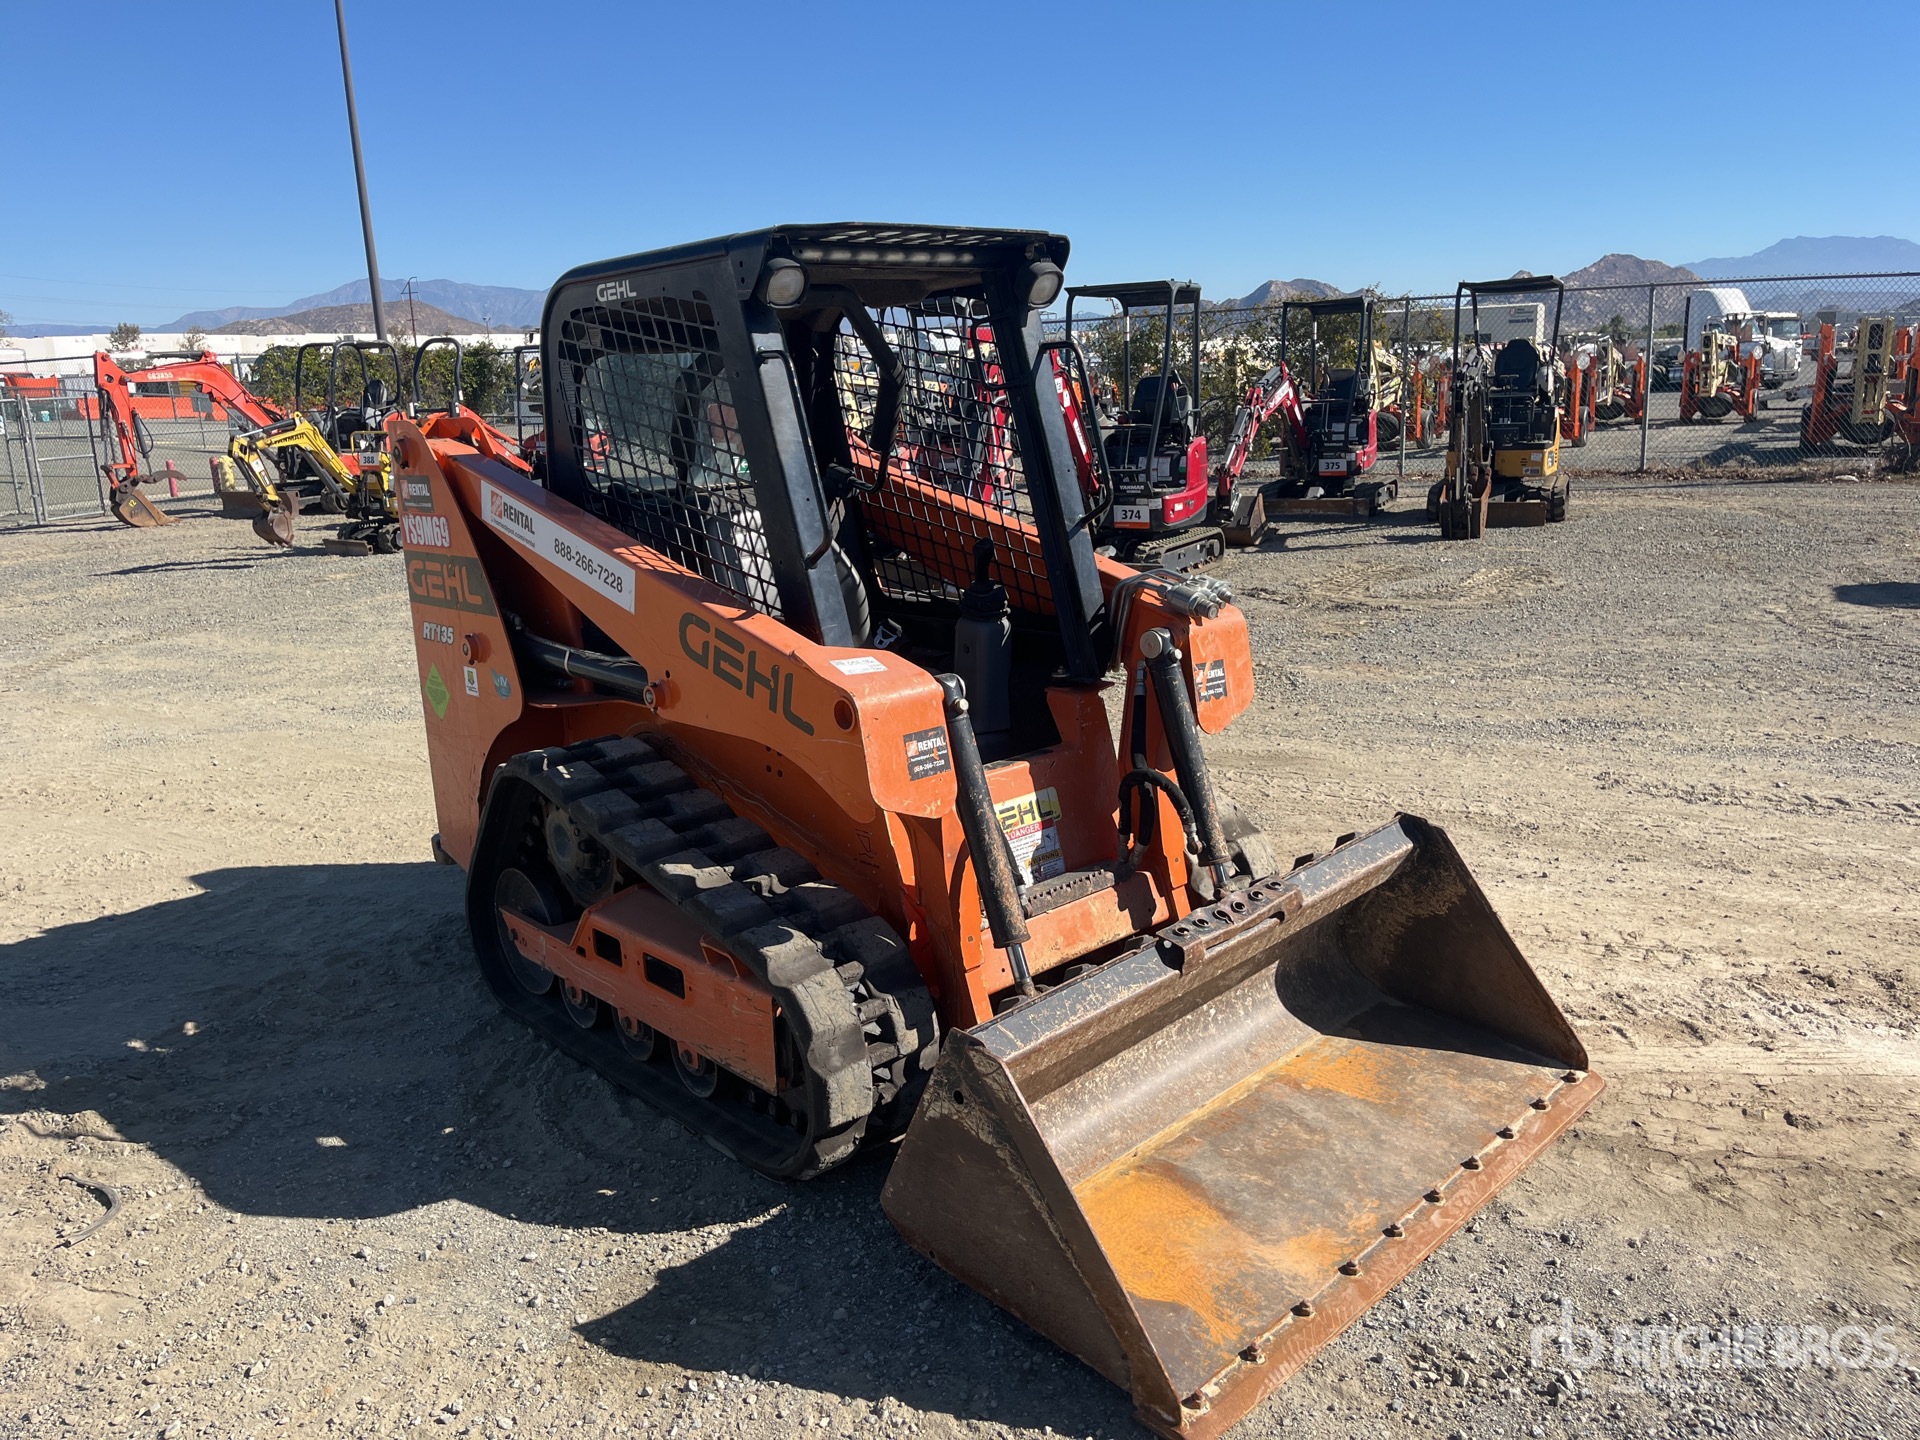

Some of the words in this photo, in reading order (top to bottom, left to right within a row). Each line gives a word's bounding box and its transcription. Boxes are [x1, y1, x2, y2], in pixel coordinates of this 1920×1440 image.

[596, 280, 637, 302] GEHL
[363, 456, 375, 464] 388
[1324, 462, 1341, 470] 375
[408, 483, 430, 496] RENTAL
[503, 501, 536, 535] RENTAL
[1121, 509, 1142, 520] 374
[402, 514, 450, 548] YS9M69
[554, 538, 623, 593] 888-266-7228
[408, 559, 483, 605] GEHL
[423, 621, 455, 645] RT135
[679, 612, 815, 736] GEHL
[917, 735, 947, 751] RENTAL
[998, 797, 1054, 831] EHL
[1010, 822, 1041, 840] DANGER
[1033, 850, 1060, 865] WARNING
